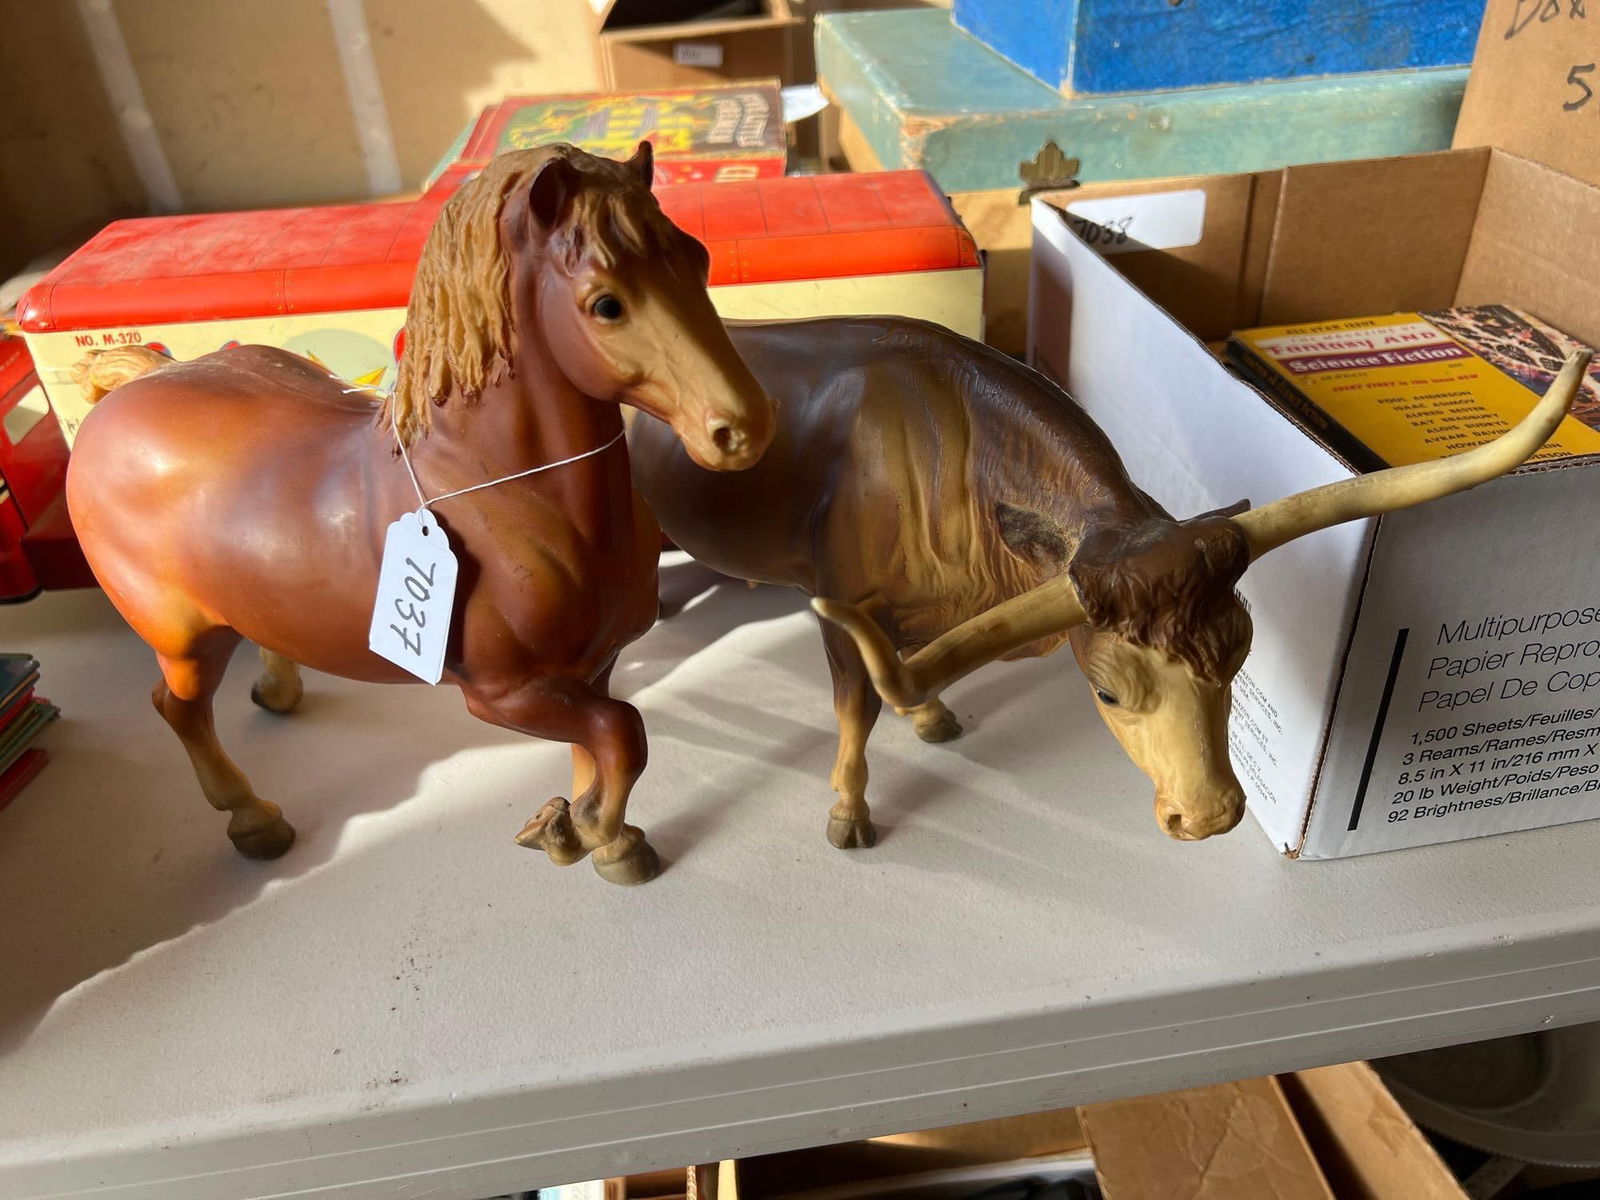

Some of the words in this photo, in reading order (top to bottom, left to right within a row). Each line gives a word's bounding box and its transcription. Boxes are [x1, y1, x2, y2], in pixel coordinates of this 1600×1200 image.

[1562, 62, 1596, 112] 5
[75, 335, 99, 347] NO.
[103, 332, 142, 346] M-320
[1269, 338, 1375, 355] Fantasy
[1384, 331, 1436, 345] AND
[1288, 355, 1380, 373] Science
[1380, 346, 1463, 364] Fiction
[1366, 381, 1395, 389] STORY
[1378, 394, 1407, 404] POUL
[1413, 390, 1473, 401] ANDERSON
[1393, 402, 1429, 411] ISAAC
[1433, 398, 1475, 408] ASIMOV
[1405, 409, 1445, 419] ALFRED
[1450, 405, 1486, 414] BESTER
[1411, 418, 1435, 427] RAY
[1441, 413, 1499, 423] BRADBURY
[1426, 424, 1460, 434] ALGIS
[1472, 420, 1509, 430] BUDRYS
[1424, 432, 1468, 443] AVRAM
[390, 557, 437, 657] 7037
[1427, 650, 1515, 680] Papier
[1520, 640, 1600, 666] Repro
[1418, 682, 1495, 712] Papel
[1500, 678, 1538, 700] De
[1411, 726, 1458, 746] 1,500
[1398, 769, 1426, 785] 8.5
[1429, 767, 1445, 780] in
[1449, 762, 1465, 777] X
[1469, 759, 1486, 773] 11
[1490, 751, 1544, 771] in/216
[1547, 749, 1579, 762] mm
[1583, 742, 1600, 756] X
[1402, 753, 1414, 766] 3
[1391, 789, 1414, 805] 20
[1418, 787, 1435, 801] lb
[1440, 764, 1600, 797] Weight/Poids/Peso
[1387, 809, 1409, 823] 92
